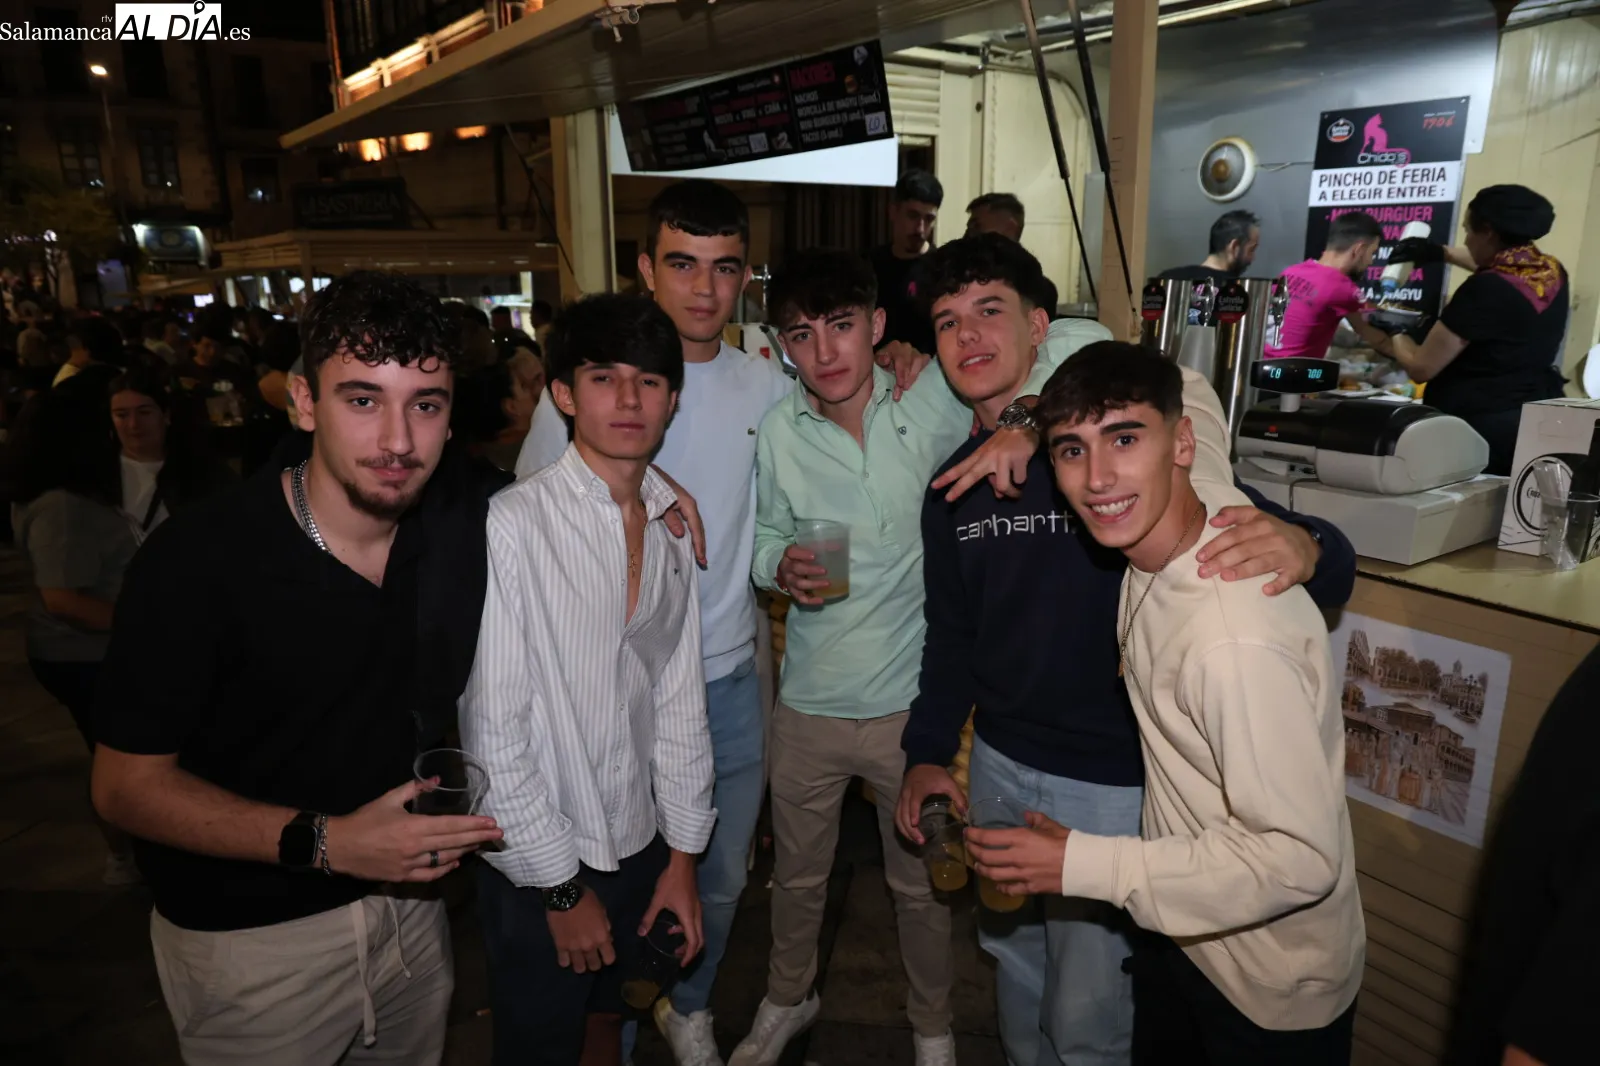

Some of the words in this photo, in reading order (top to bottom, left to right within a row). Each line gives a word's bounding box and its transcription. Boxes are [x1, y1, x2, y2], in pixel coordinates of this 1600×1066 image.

[1319, 171, 1373, 188] PINCHO
[1377, 169, 1397, 185] DE
[1401, 167, 1447, 184] FERIA
[1318, 190, 1328, 201] A
[1331, 187, 1383, 201] ELEGIR
[1386, 185, 1438, 199] ENTRE
[956, 510, 1073, 541] carhartt
